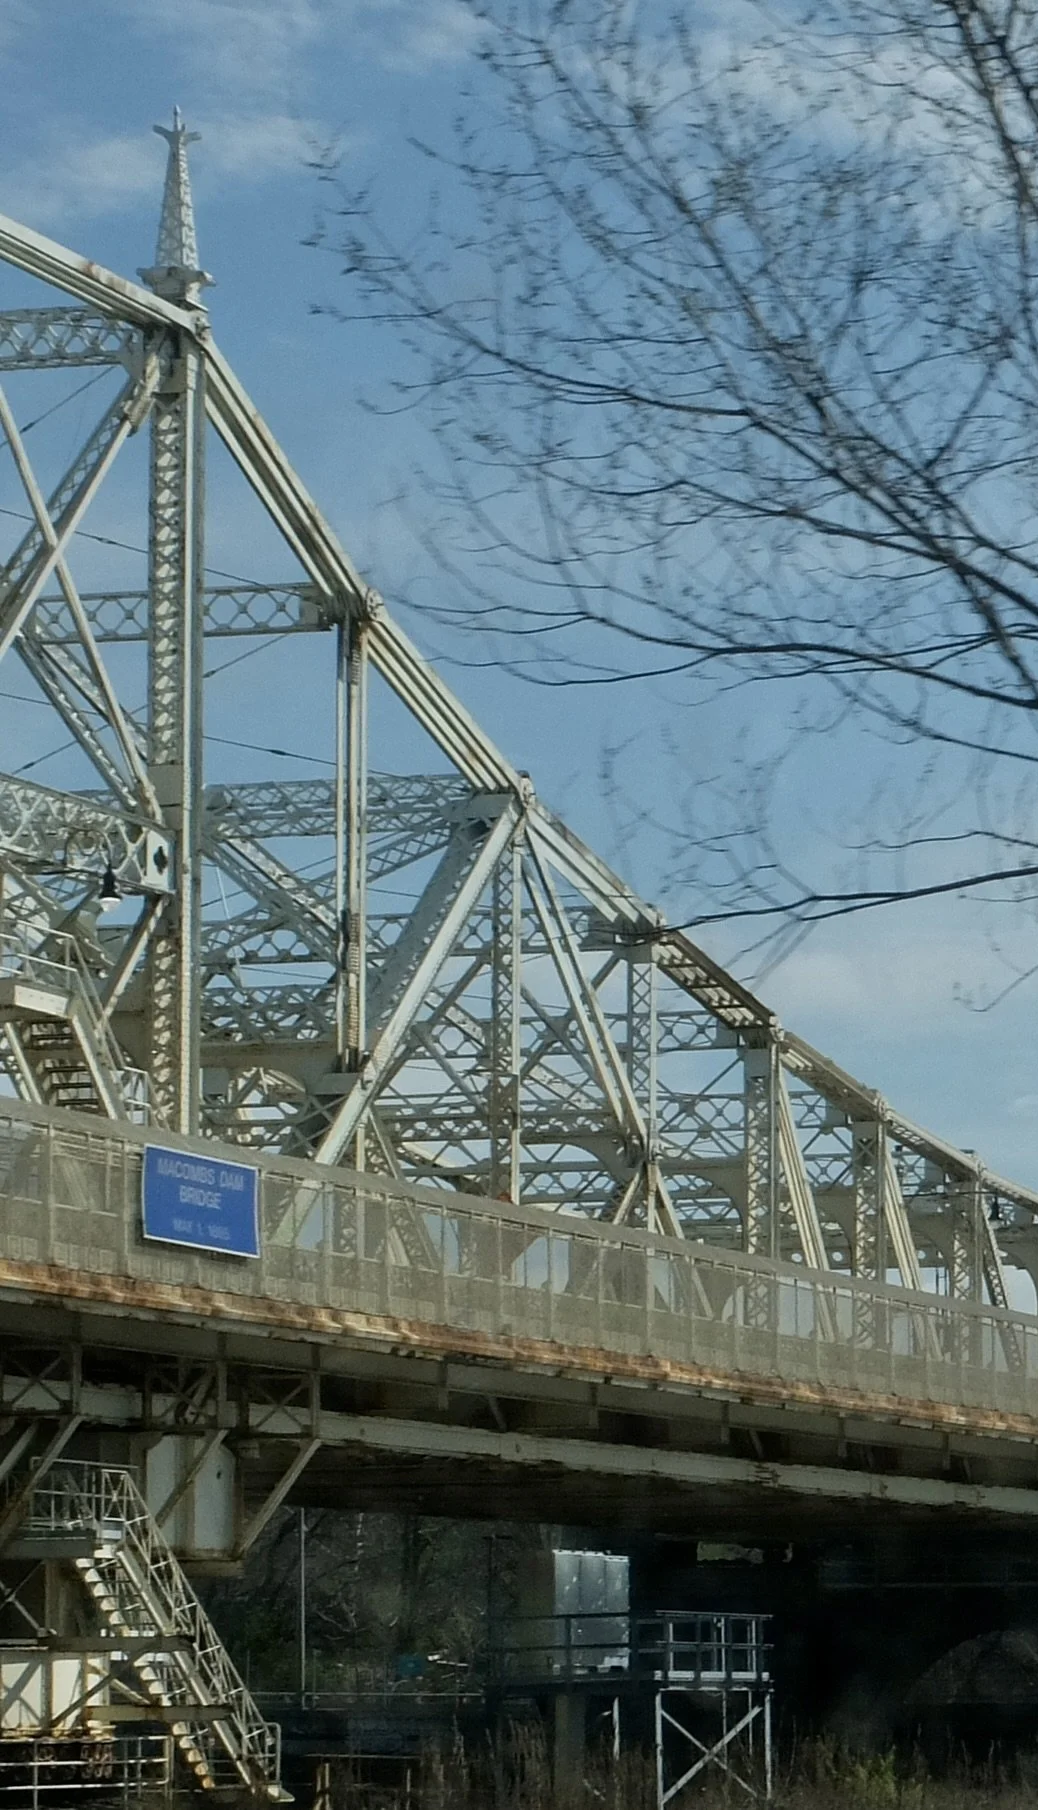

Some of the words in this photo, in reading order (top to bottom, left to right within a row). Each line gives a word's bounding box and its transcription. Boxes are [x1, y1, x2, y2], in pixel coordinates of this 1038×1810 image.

[157, 1158, 215, 1185] MACOMBS
[220, 1170, 244, 1191] DAM
[179, 1185, 221, 1209] BRIDGE
